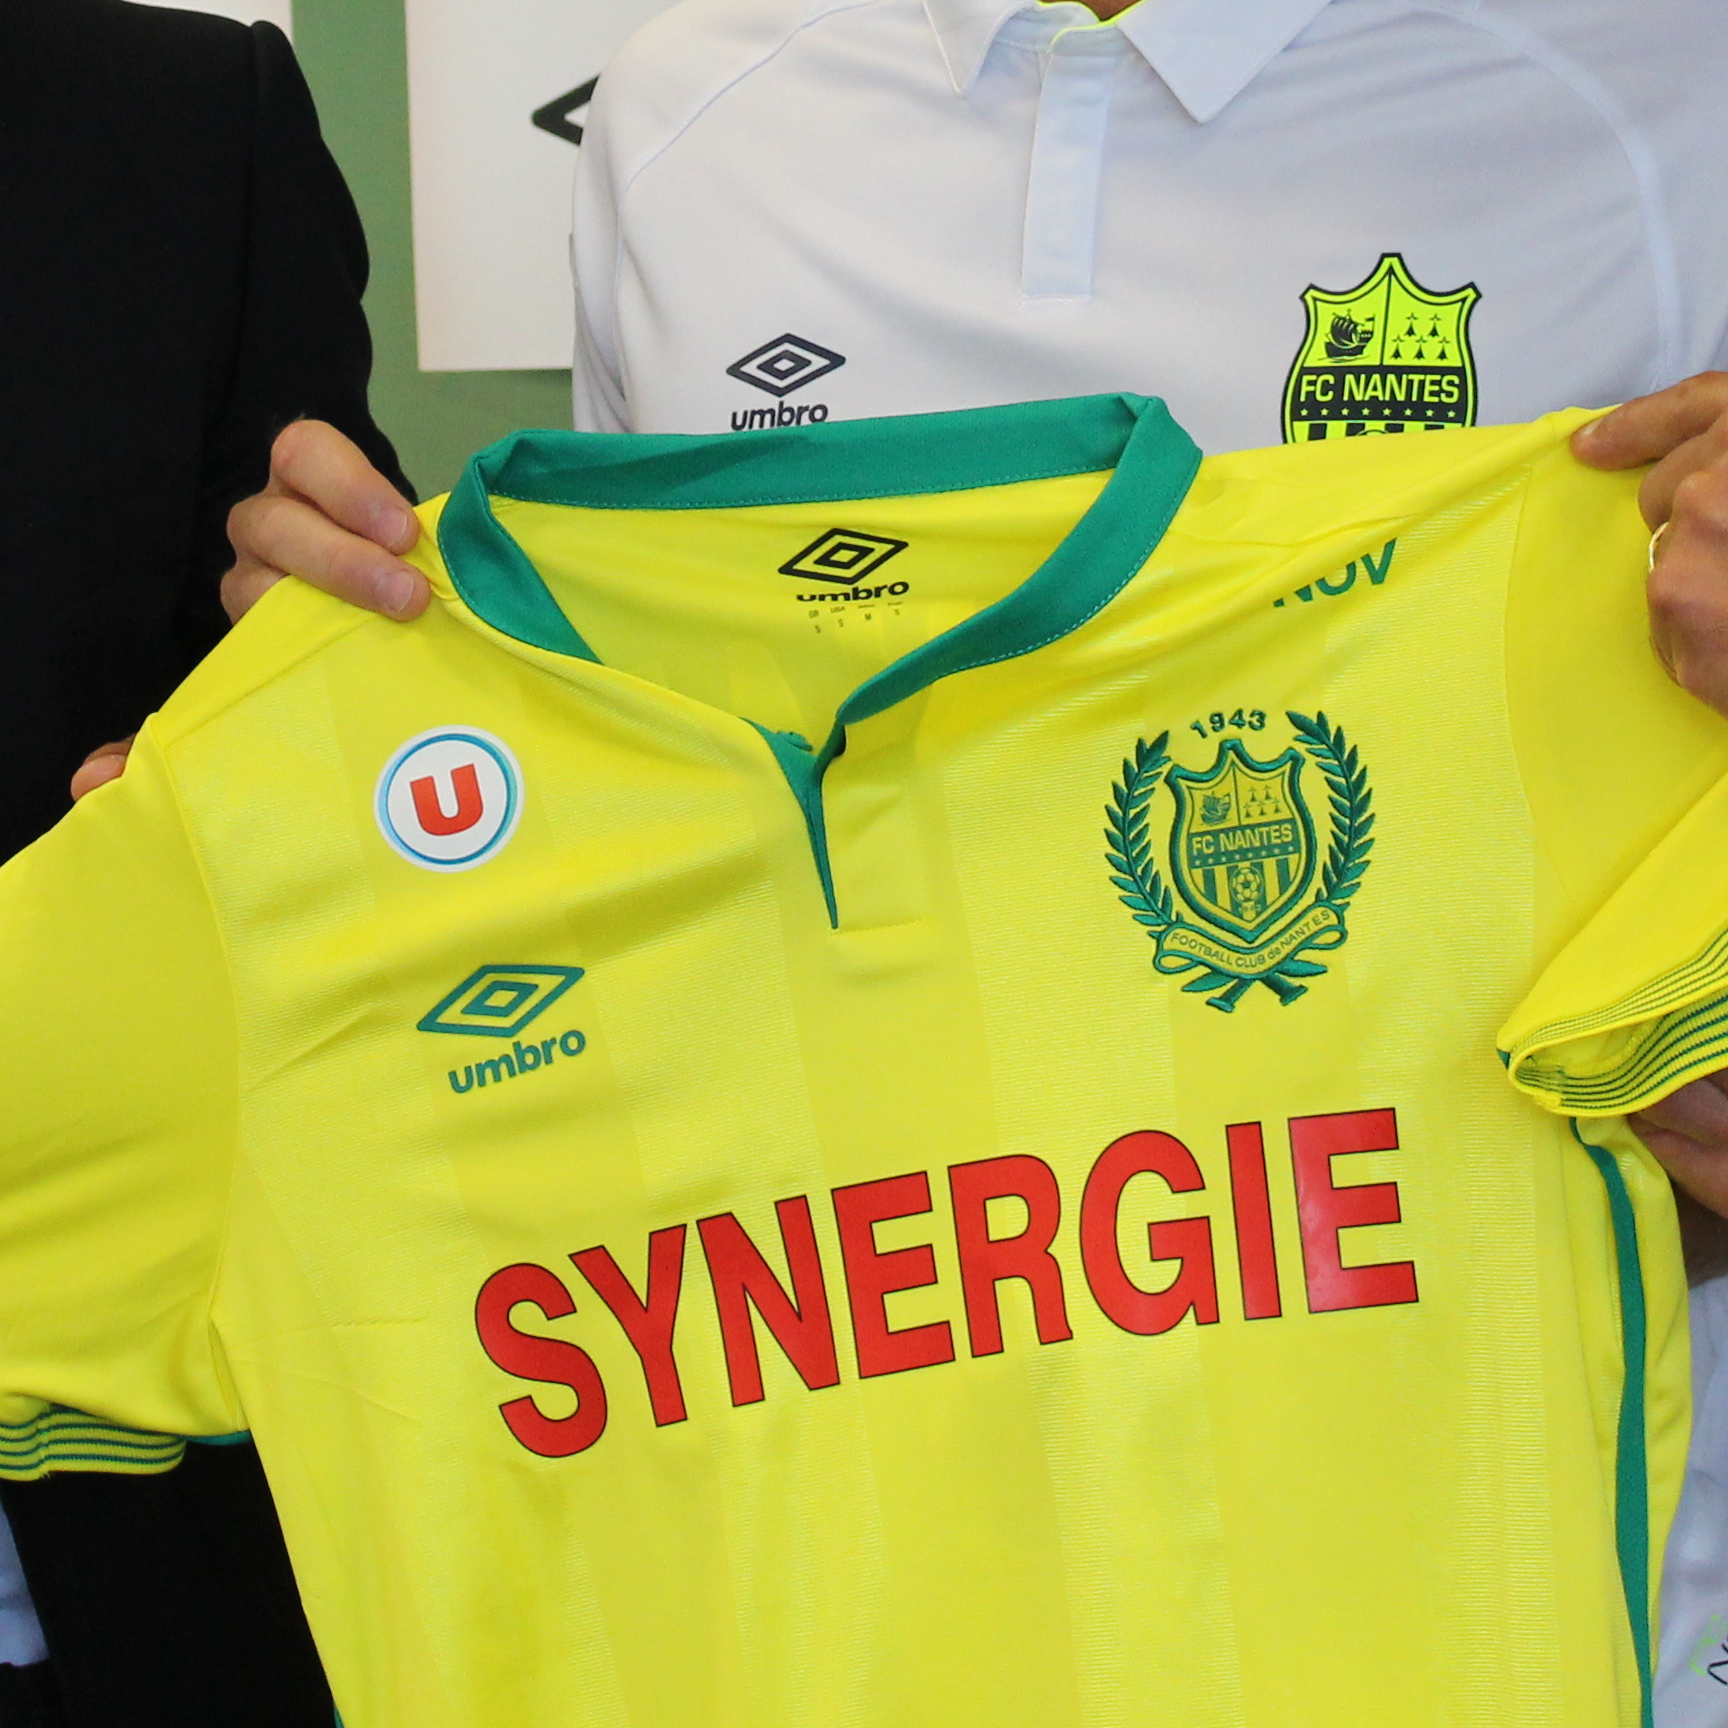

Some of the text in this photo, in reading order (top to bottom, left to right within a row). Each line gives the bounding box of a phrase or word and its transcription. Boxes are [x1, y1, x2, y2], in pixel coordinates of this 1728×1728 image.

[1299, 374, 1461, 404] FC NANTES
[731, 401, 829, 432] umbro
[796, 581, 910, 602] umbro
[1273, 537, 1398, 608] OV
[1190, 708, 1267, 739] 1943
[409, 763, 485, 837] U
[1191, 823, 1294, 856] FC NANTES
[1171, 909, 1331, 969] FOOTBALL CLUB de NANTES
[448, 1029, 585, 1094] umbro
[473, 1106, 1419, 1458] SYNERGIE
